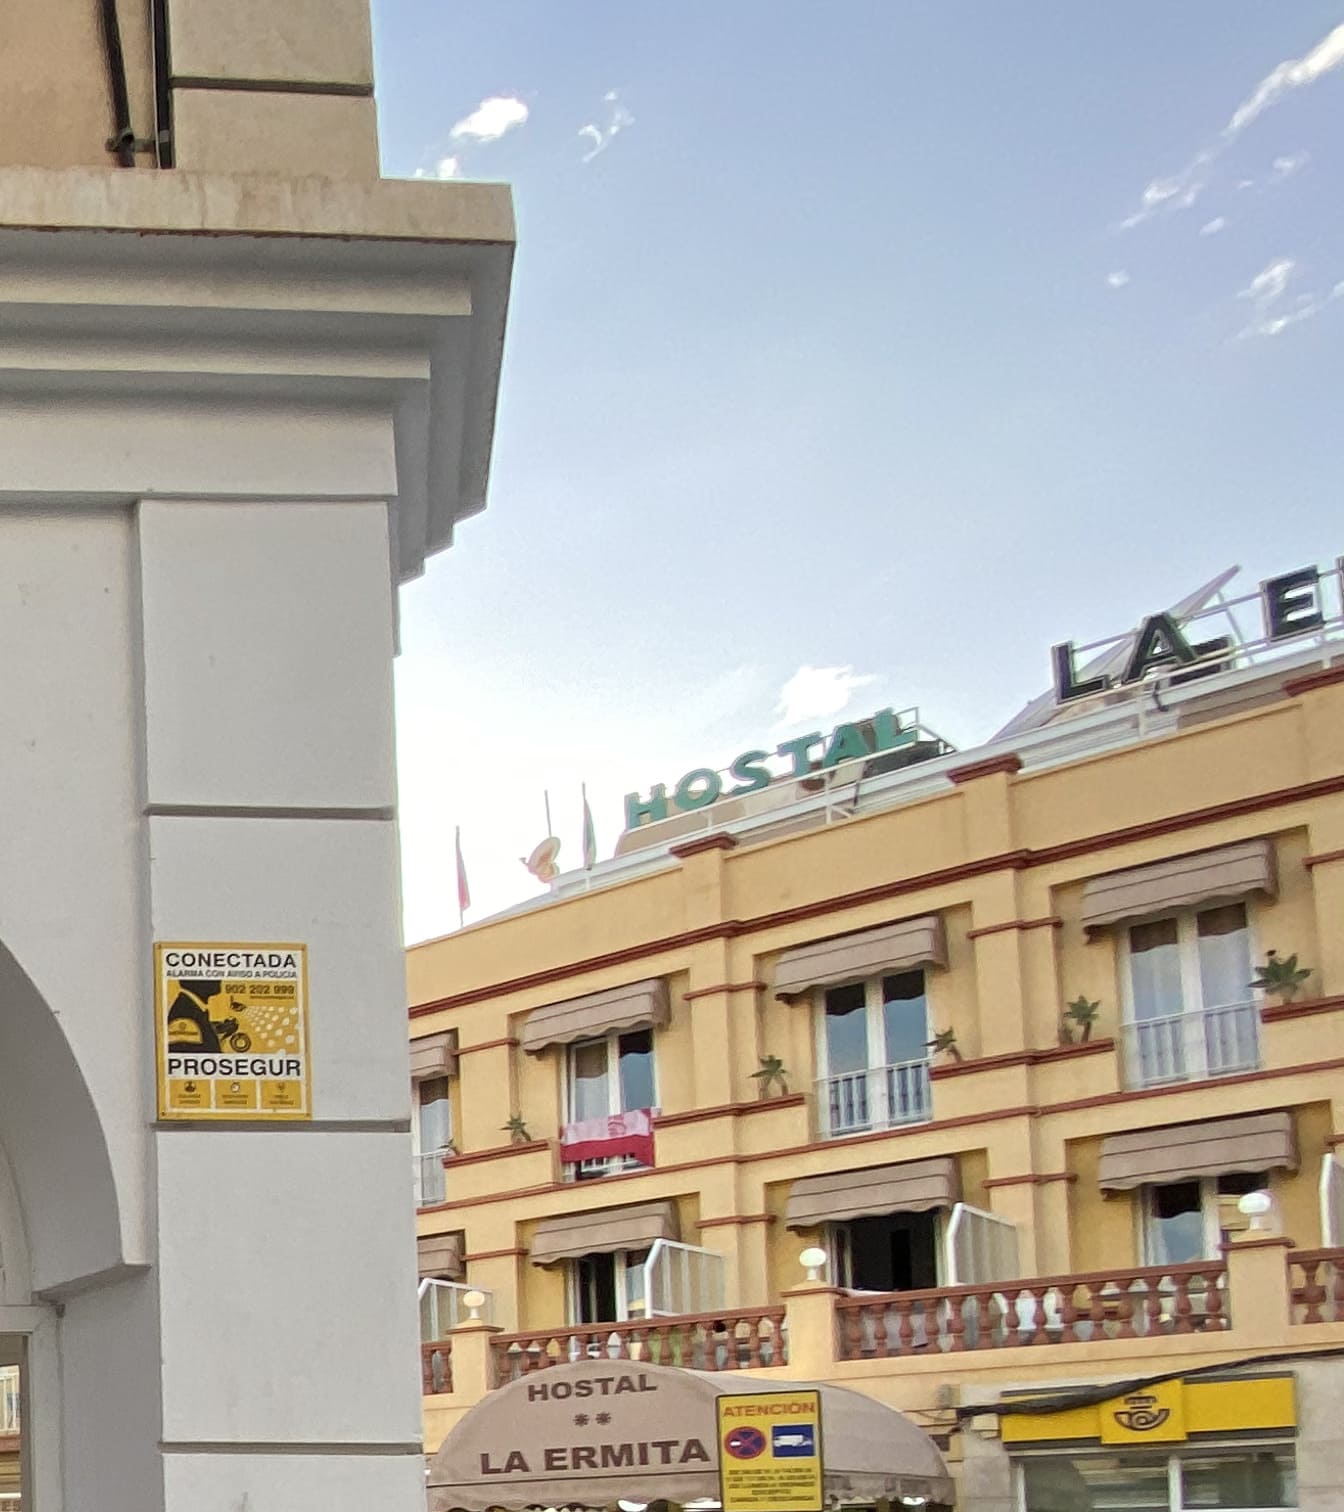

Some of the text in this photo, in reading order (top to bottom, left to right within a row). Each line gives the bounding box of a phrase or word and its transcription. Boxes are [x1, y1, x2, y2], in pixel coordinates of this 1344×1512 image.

[1051, 611, 1200, 704] LA
[624, 707, 918, 829] HOSTAL
[166, 953, 296, 968] CONECTADA
[168, 1059, 301, 1076] PROSEGUR
[528, 1374, 657, 1402] HOSTAL
[480, 1438, 711, 1475] LA ERMITA
